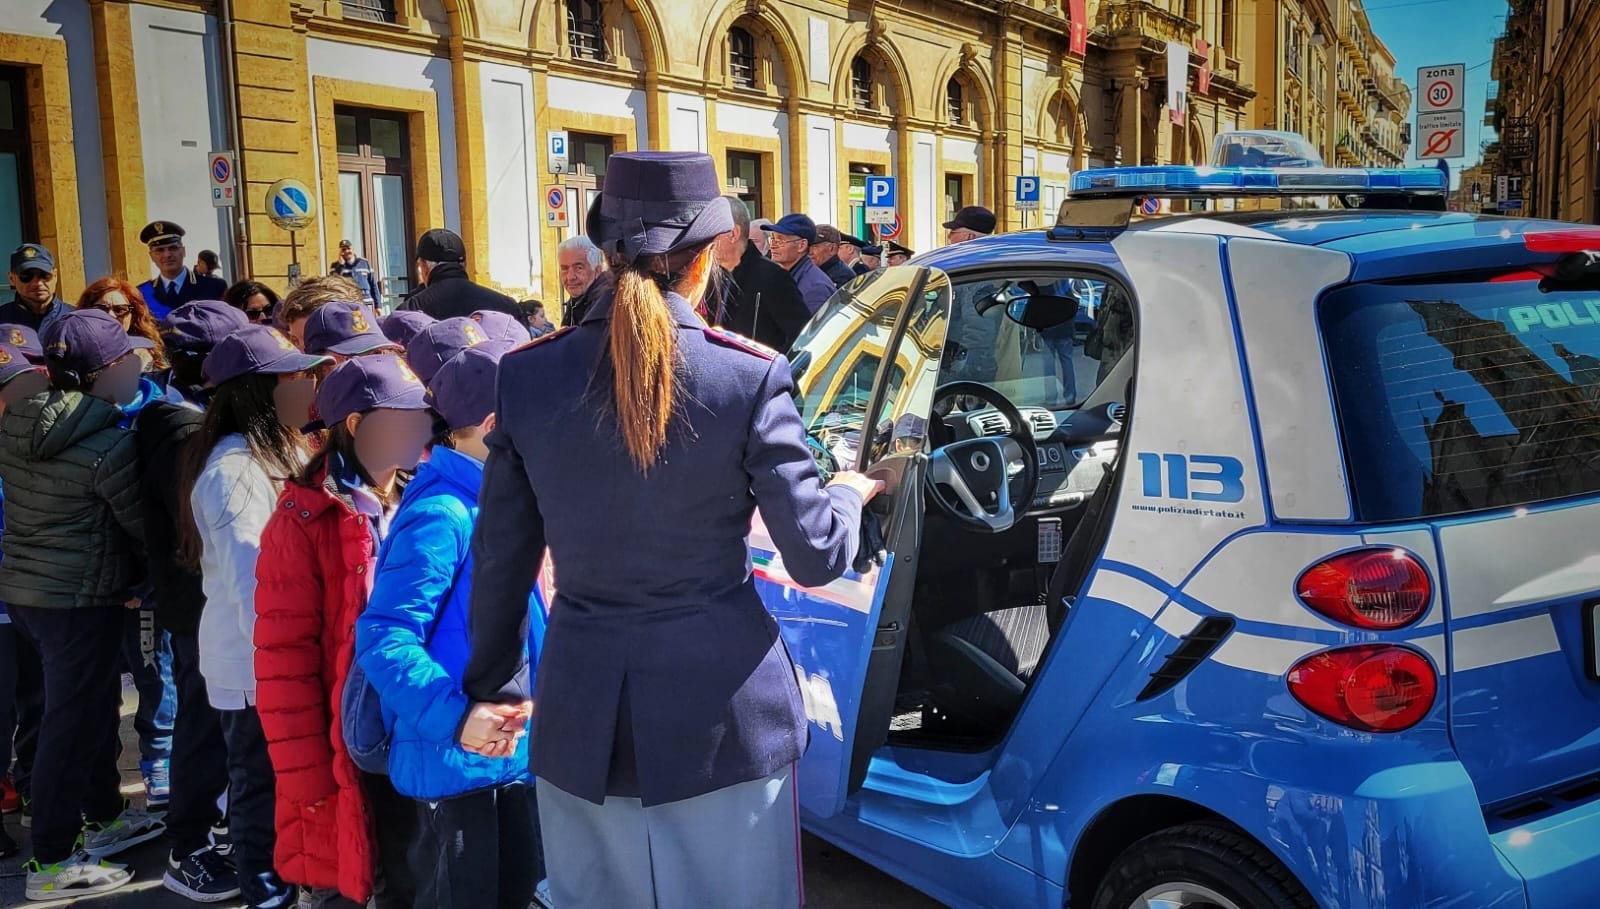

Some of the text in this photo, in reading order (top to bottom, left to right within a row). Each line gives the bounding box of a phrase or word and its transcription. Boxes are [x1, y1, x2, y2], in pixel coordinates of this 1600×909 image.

[1426, 68, 1455, 78] zona
[1433, 88, 1448, 101] 30
[554, 138, 562, 153] P
[1020, 178, 1036, 199] P
[1509, 177, 1521, 191] T
[872, 180, 889, 204] P
[1508, 299, 1600, 332] POLI
[1137, 452, 1245, 504] 113
[1132, 504, 1247, 519] www.poliziadistato.it
